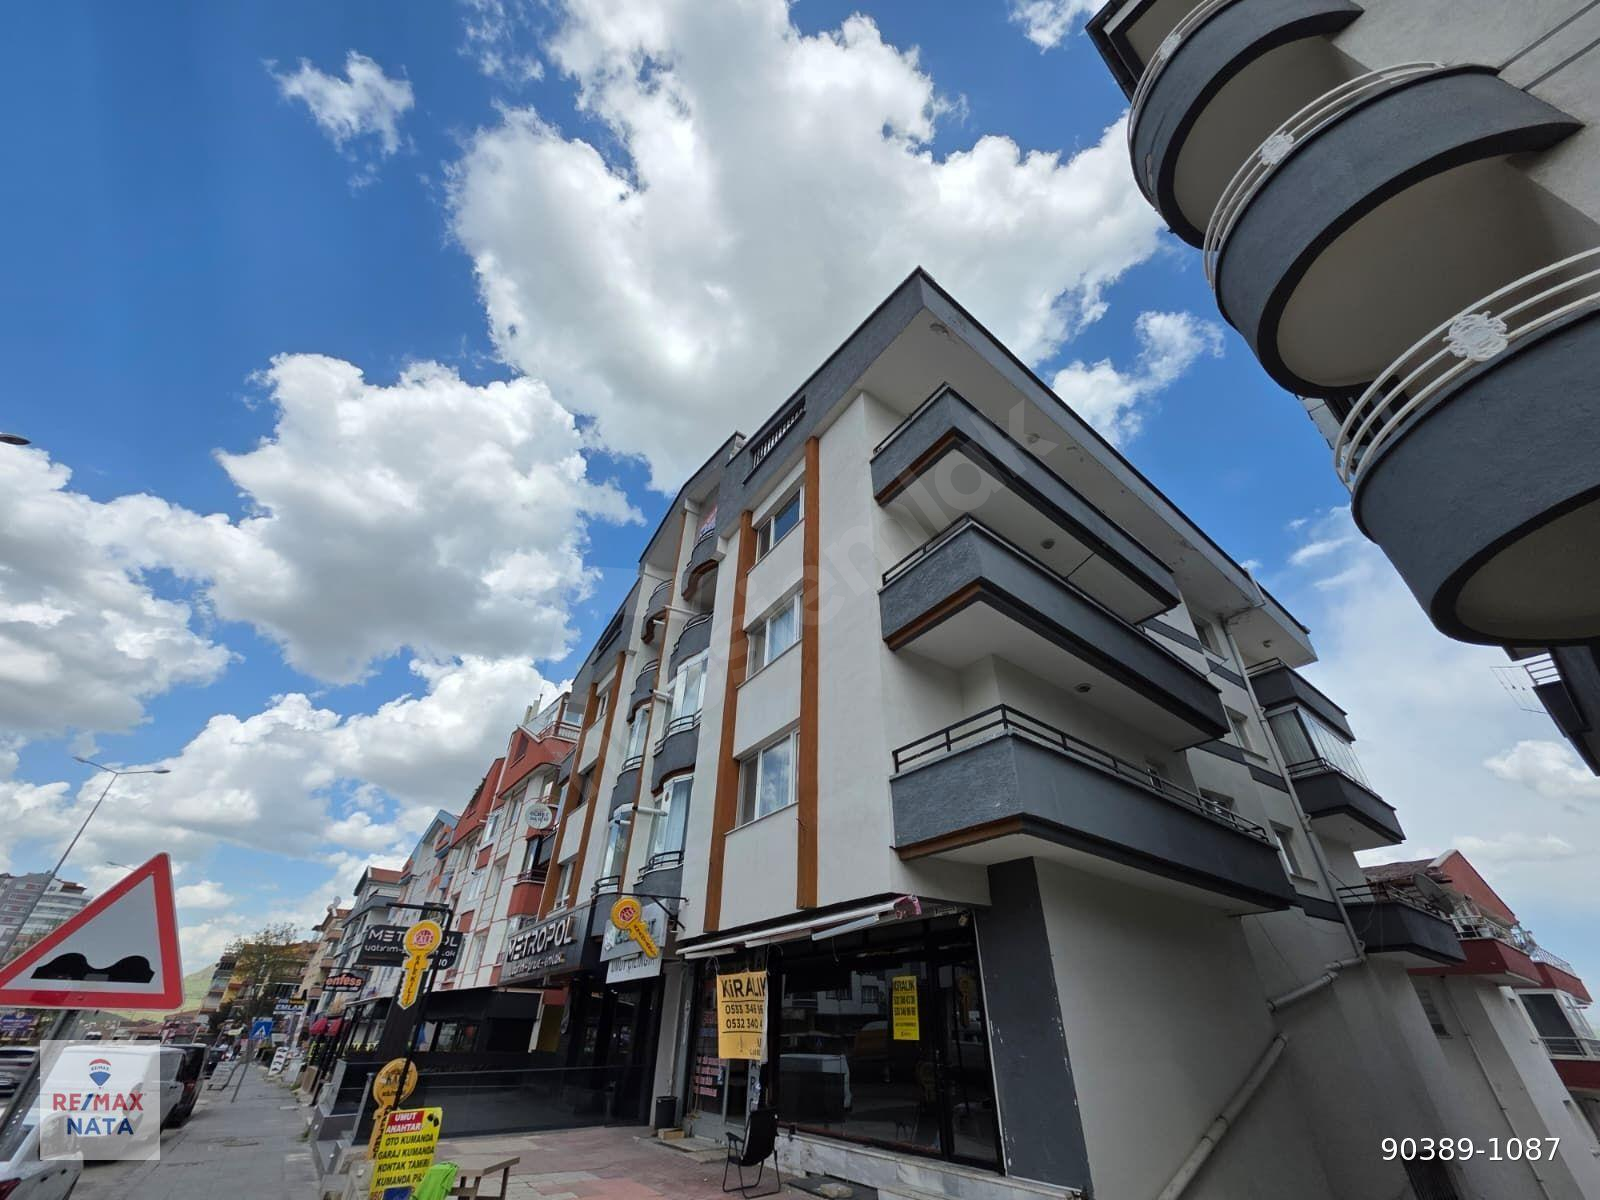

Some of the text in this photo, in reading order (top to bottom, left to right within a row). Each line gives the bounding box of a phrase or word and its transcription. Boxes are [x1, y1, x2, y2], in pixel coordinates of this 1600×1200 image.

[507, 916, 573, 961] METROPOL
[726, 1019, 745, 1028] 0532
[394, 1112, 417, 1122] UMUT
[385, 1134, 434, 1146] OTO KUMANDA
[378, 1146, 435, 1160] GARAJ KUMANDA
[377, 1161, 406, 1172] KONTAK
[376, 1174, 410, 1187] KUMANDA
